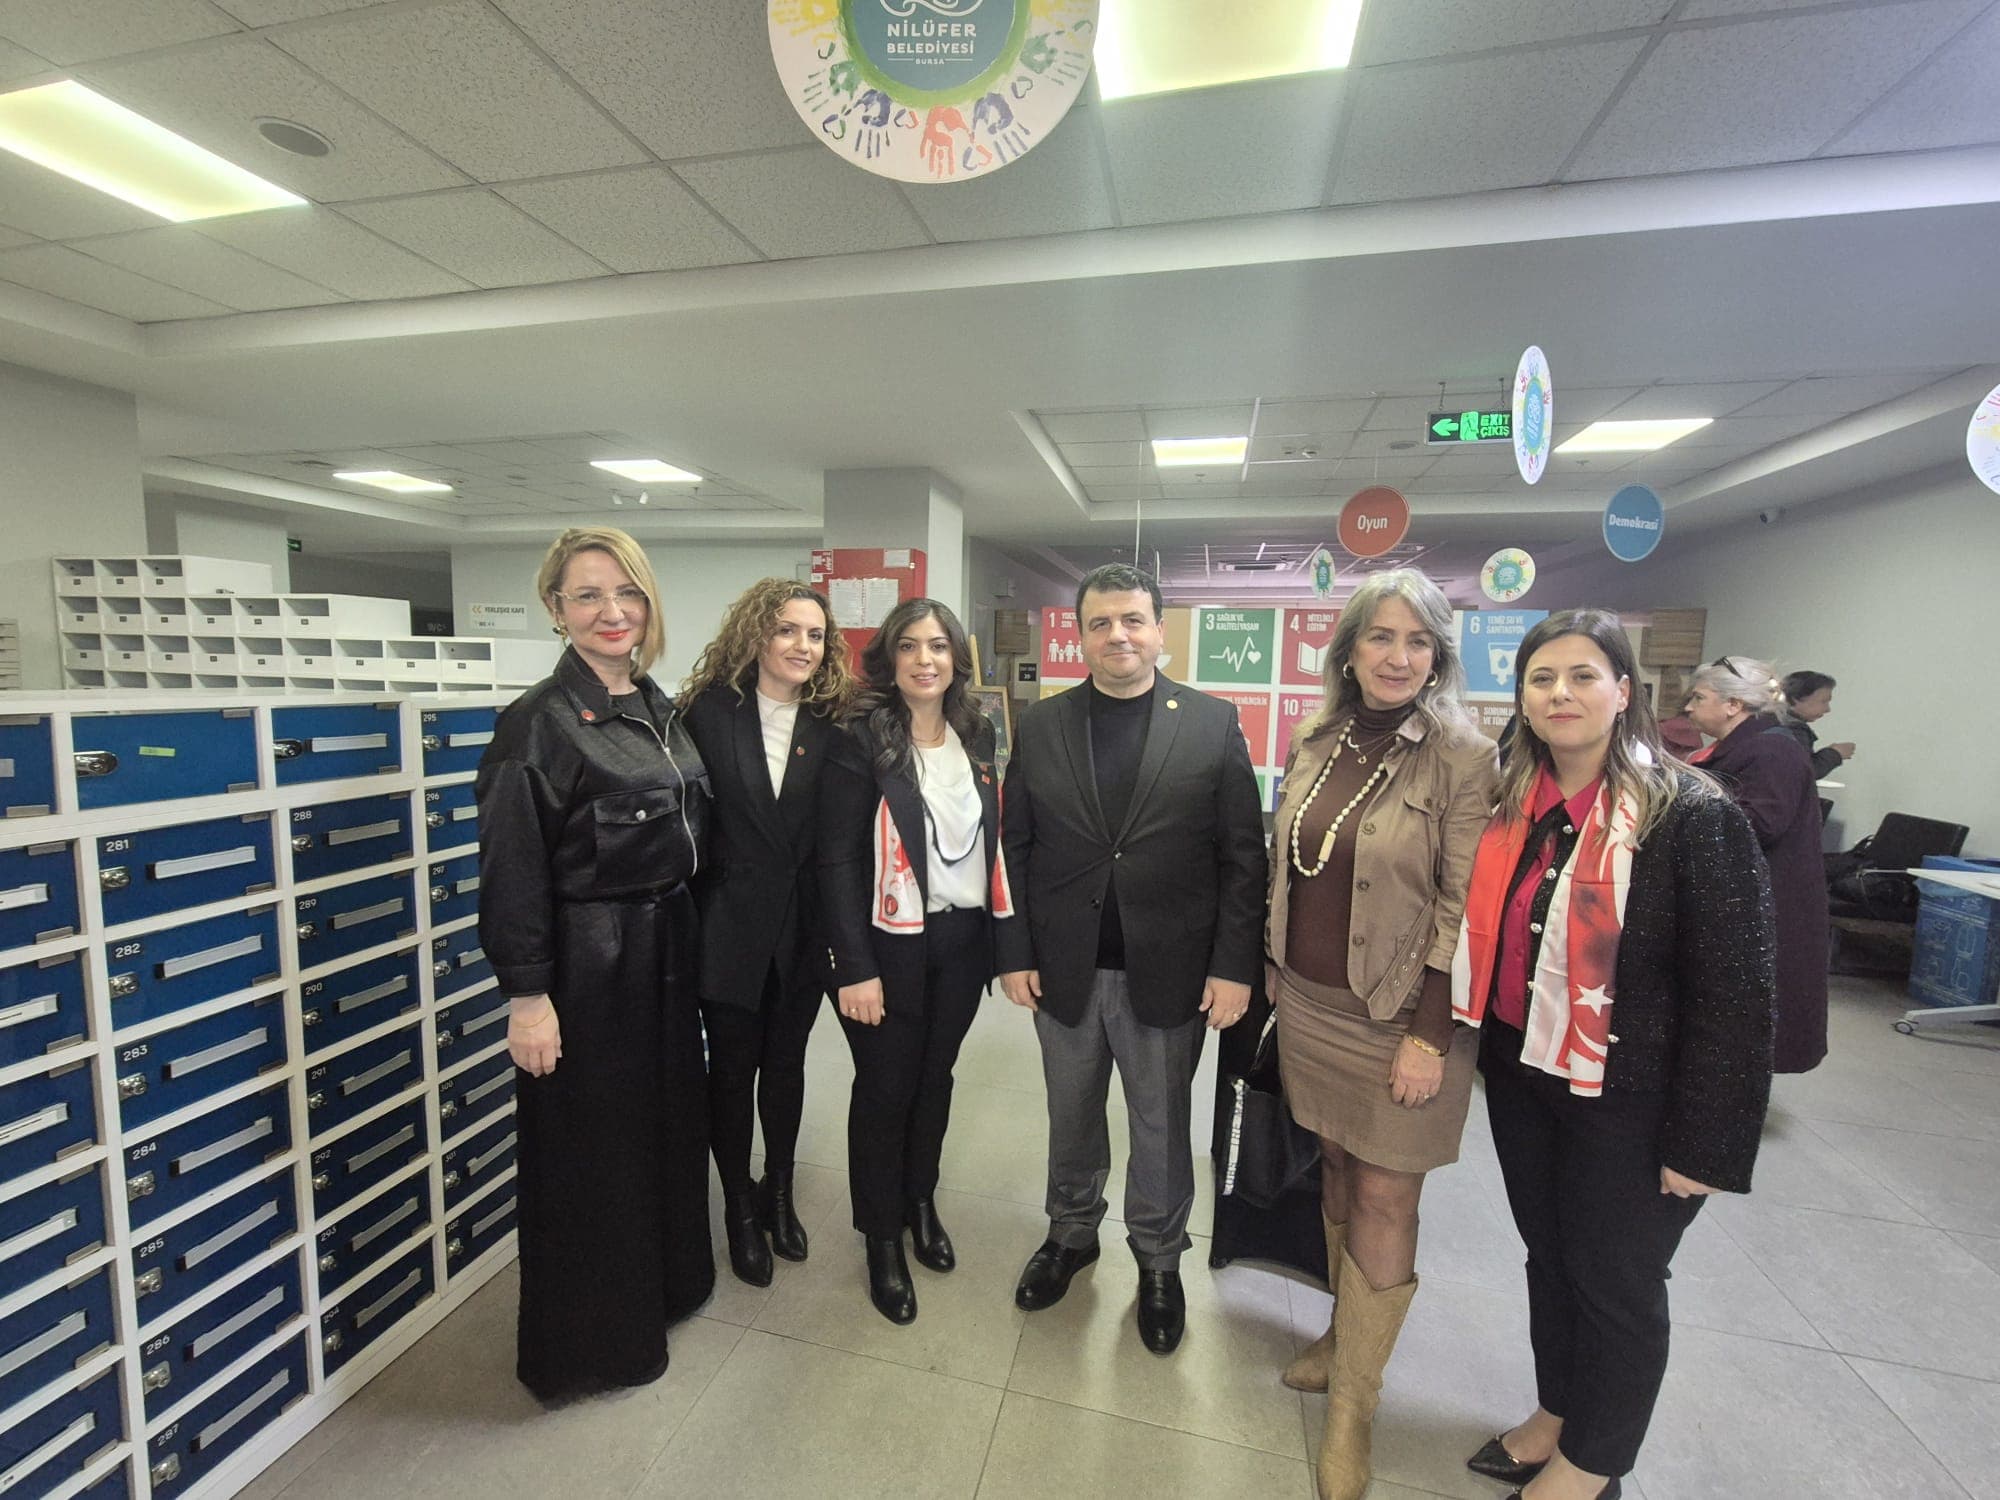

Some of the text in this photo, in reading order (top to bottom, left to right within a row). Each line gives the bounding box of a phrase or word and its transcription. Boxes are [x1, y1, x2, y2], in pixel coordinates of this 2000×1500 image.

[887, 19, 976, 37] NİLÜFER
[887, 40, 974, 54] BELEDİYESİ
[1480, 413, 1510, 426] EXIT
[1480, 425, 1510, 438] ÇIKIŞ
[1357, 514, 1388, 534] Oyun
[1609, 513, 1660, 531] Demokrasi
[1048, 611, 1056, 628] 1
[1205, 613, 1215, 630] 3
[1289, 613, 1300, 631] 4
[1470, 616, 1480, 634] 6
[1283, 698, 1299, 716] 10
[423, 713, 437, 722] 295
[426, 792, 440, 802] 296
[293, 810, 312, 821] 288
[106, 839, 129, 852] 281
[432, 865, 445, 875] 297
[299, 898, 317, 910] 289
[115, 943, 141, 958] 282
[305, 982, 323, 996] 290
[123, 1044, 148, 1061] 283
[311, 1066, 326, 1080] 291
[132, 1142, 157, 1160] 284
[314, 1149, 331, 1164] 292
[320, 1225, 337, 1242] 293
[139, 1238, 164, 1258] 285
[146, 1335, 170, 1355] 286
[157, 1423, 179, 1447] 287
